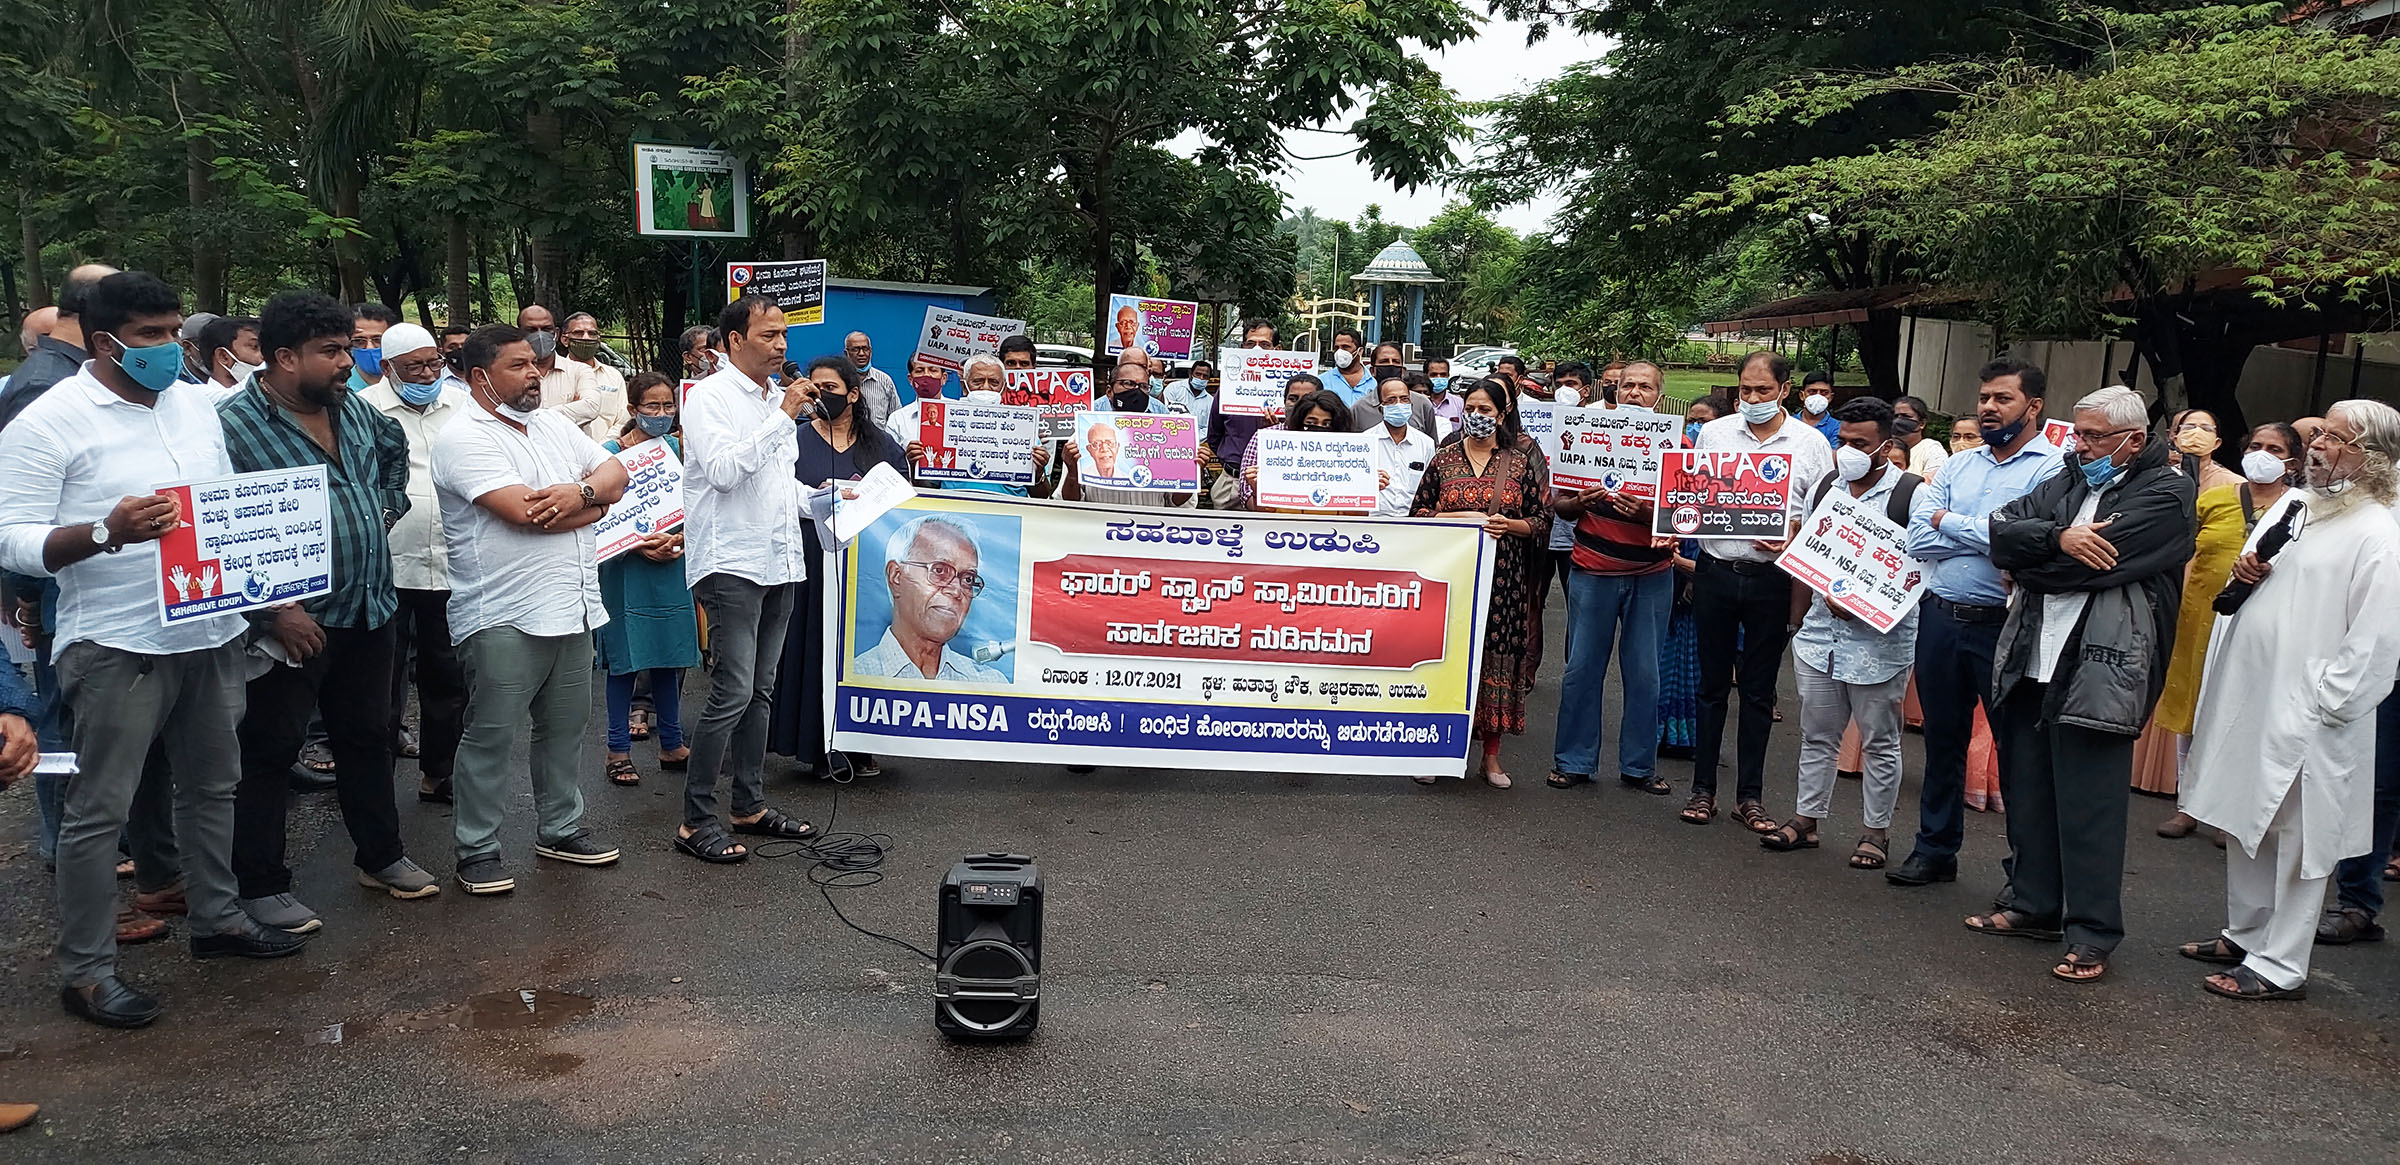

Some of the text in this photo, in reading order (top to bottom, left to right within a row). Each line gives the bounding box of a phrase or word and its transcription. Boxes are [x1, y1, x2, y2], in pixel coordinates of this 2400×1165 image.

[1138, 302, 1192, 320] ಫಾದರ್ ಸ್ವಾಮಿ
[1150, 314, 1174, 326] ನೀವು
[946, 327, 971, 344] ನಮ್ಮ
[928, 340, 948, 352] UAPA
[954, 346, 970, 356] NSA
[1246, 354, 1314, 371] ಅಘೋಷಿತ
[1005, 370, 1068, 394] UAPA
[1240, 372, 1262, 382] STAN
[1115, 416, 1191, 436] ಫಾದರ್ ಸ್ವಾಮಿ
[1564, 414, 1672, 434] ಜಲ್-ಜಮೀನ್-ಜಂಗಲ್
[1133, 431, 1167, 444] ನೀವು
[1300, 440, 1322, 452] NSA
[1580, 430, 1652, 456] ನಮ್ಮ ಹಕ್ಕು
[1164, 448, 1194, 461] ಇರುವಿರಿ
[1266, 455, 1370, 474] ಜನಪರ ಹೋರಾಟಗಾರರನ್ನು
[1560, 452, 1586, 466] UAPA
[1594, 456, 1615, 468] NSA
[1618, 457, 1638, 475] ನಿಮ್ಮ
[1682, 450, 1759, 480] UAPA
[1282, 471, 1351, 482] ಬಿಡುಗಡೆಗೊಳಿಸಿ
[200, 475, 321, 505] ಭೀಮಾ ಕೊರೆಗಾಂವ್ ಹೆಸರಲ್ಲಿ
[1666, 488, 1783, 506] ಕರಾಳ ಕಾನೂನು
[202, 508, 230, 530] ಸುಳ್ಳು
[278, 498, 300, 512] ಹೇರಿ
[1676, 513, 1698, 524] UAPA
[1702, 510, 1784, 532] ರದ್ದು ಮಾಡಿ
[204, 518, 322, 554] ಸ್ವಾಮಿಯವರನ್ನು ಬಂಧಿಸಿದ್ದ
[1105, 518, 1381, 558] ಸಹಬಾಳ್ವೆ ಉಡುಪಿ
[223, 540, 326, 573] ಕೇಂದ್ರ ಸರಕಾರಕ್ಕೆ ಧಿಕ್ಕಾರ
[1836, 524, 1904, 580] ನಮ್ಮ ಹಕ್ಕು
[1804, 536, 1831, 560] UAPA
[1836, 554, 1858, 575] NSA
[1856, 570, 1878, 594] ನಿಮ್ಮ
[1060, 568, 1423, 614] ಫಾದರ್ ಸ್ಟ್ಯಾನ್ ಸ್ವಾಮಿಯವರಿಗೆ
[170, 596, 242, 618] SAHABALVE UDUPI
[1106, 620, 1373, 654] ಸಾರ್ವಜನಿಕ ನುಡಿನಮನ
[1042, 668, 1089, 685] ದಿನಾಂಕ
[1104, 669, 1182, 690] 12.07.2021
[1202, 675, 1428, 705] ಸ್ಥಳ: ಹುತಾತ್ಮ ಚೌಕ, ಅಜ್ಜರಕಾಡು, ಉಡುಪಿ
[850, 696, 1009, 732] UAPA-NSA
[1027, 706, 1112, 741] ರದ್ದುಗೊಳಿಸಿ
[1139, 714, 1190, 738] ಬಂಧಿತ
[1196, 713, 1331, 751] ಹೋರಾಟಗಾರರನ್ನು
[1337, 720, 1440, 744] ಬಿಡುಗಡೆಗೊಳಿಸಿ
